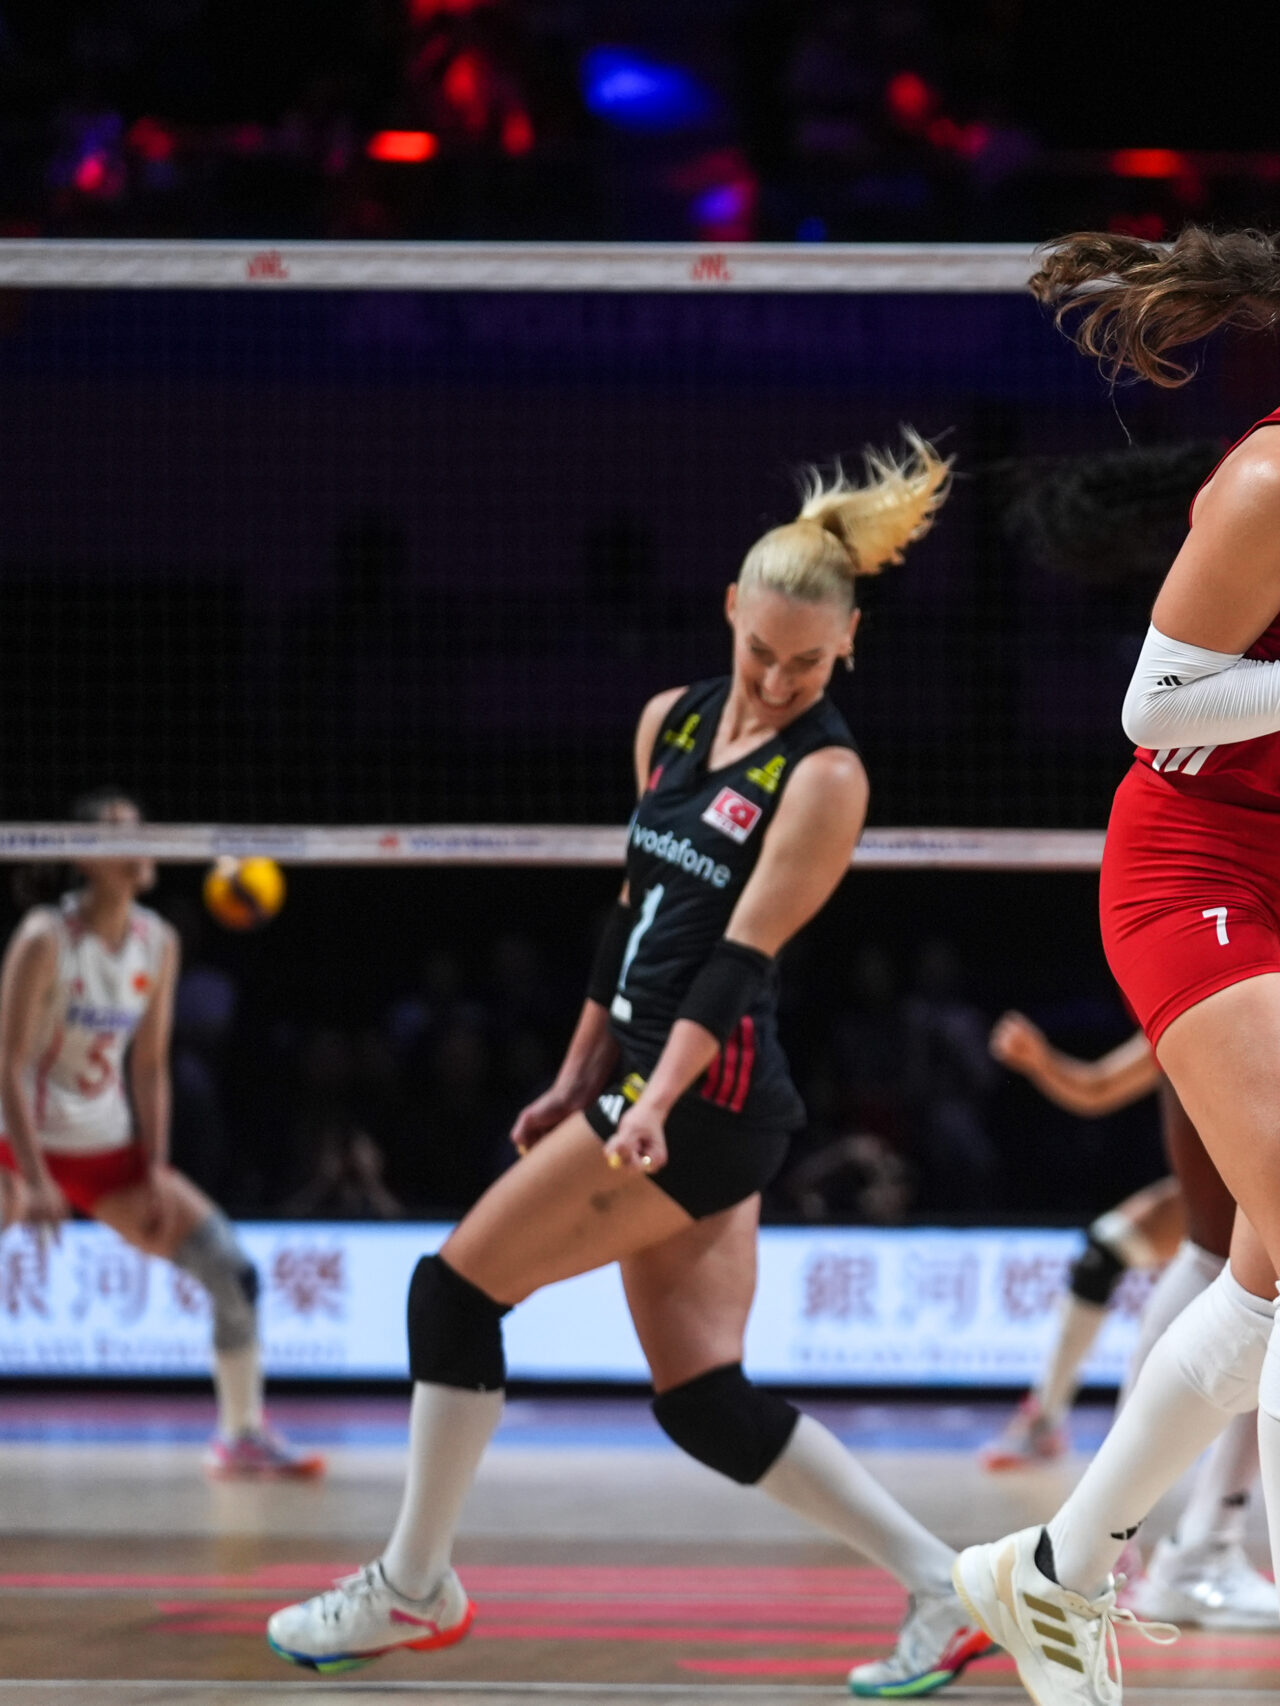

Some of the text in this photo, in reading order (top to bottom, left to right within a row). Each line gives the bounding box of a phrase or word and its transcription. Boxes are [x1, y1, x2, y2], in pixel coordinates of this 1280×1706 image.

[633, 824, 732, 889] vodafone
[617, 883, 665, 992] 1
[1202, 907, 1229, 946] 7
[74, 1032, 114, 1099] 5
